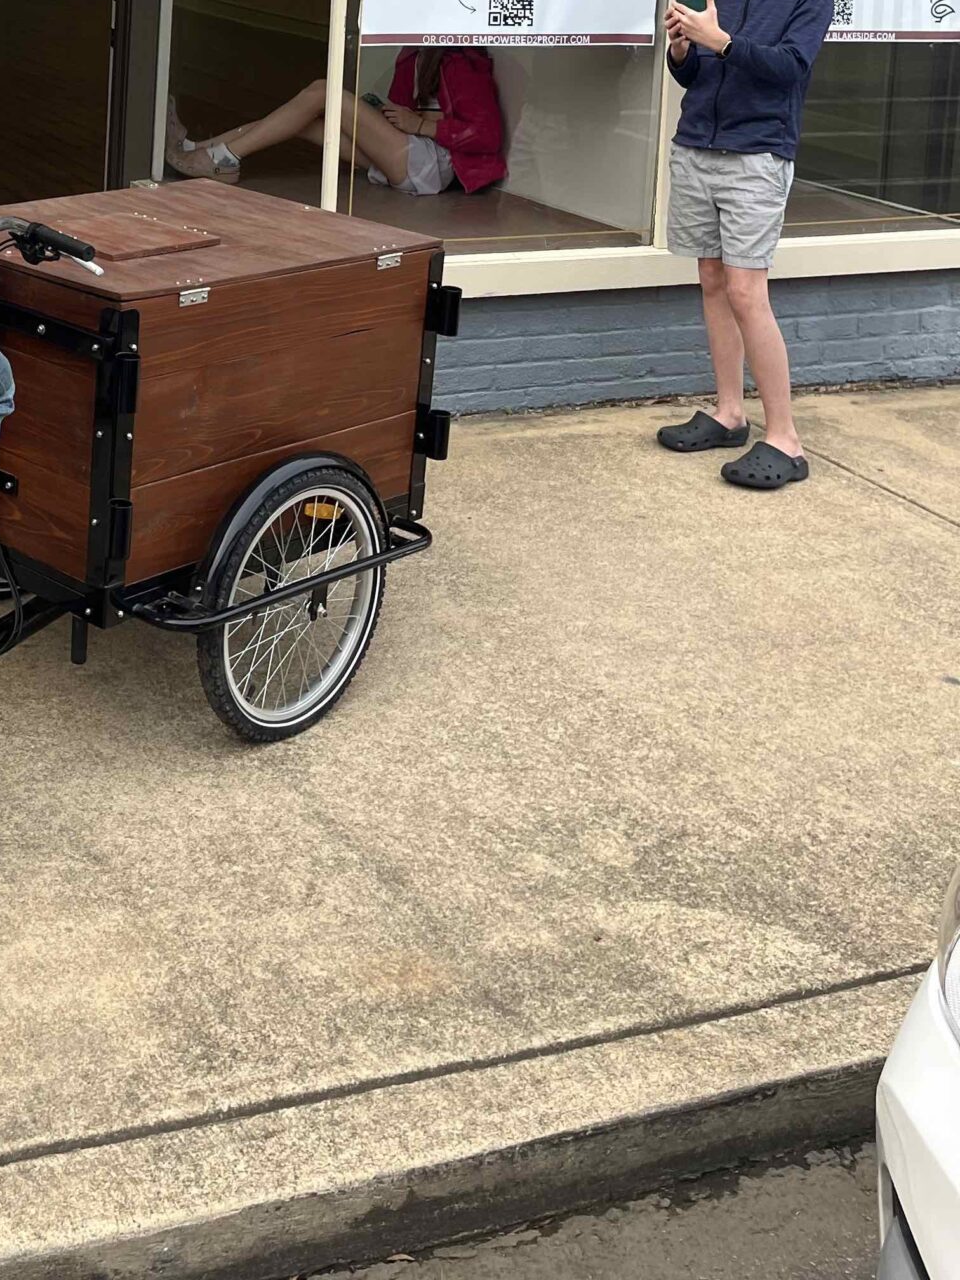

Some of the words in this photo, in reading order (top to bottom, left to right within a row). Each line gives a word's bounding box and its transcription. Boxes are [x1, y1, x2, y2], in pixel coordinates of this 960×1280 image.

[422, 35, 437, 44] OR
[440, 35, 454, 44] GO
[456, 35, 470, 44] TO
[472, 36, 590, 44] EMPOWERED2PROFIT.COM
